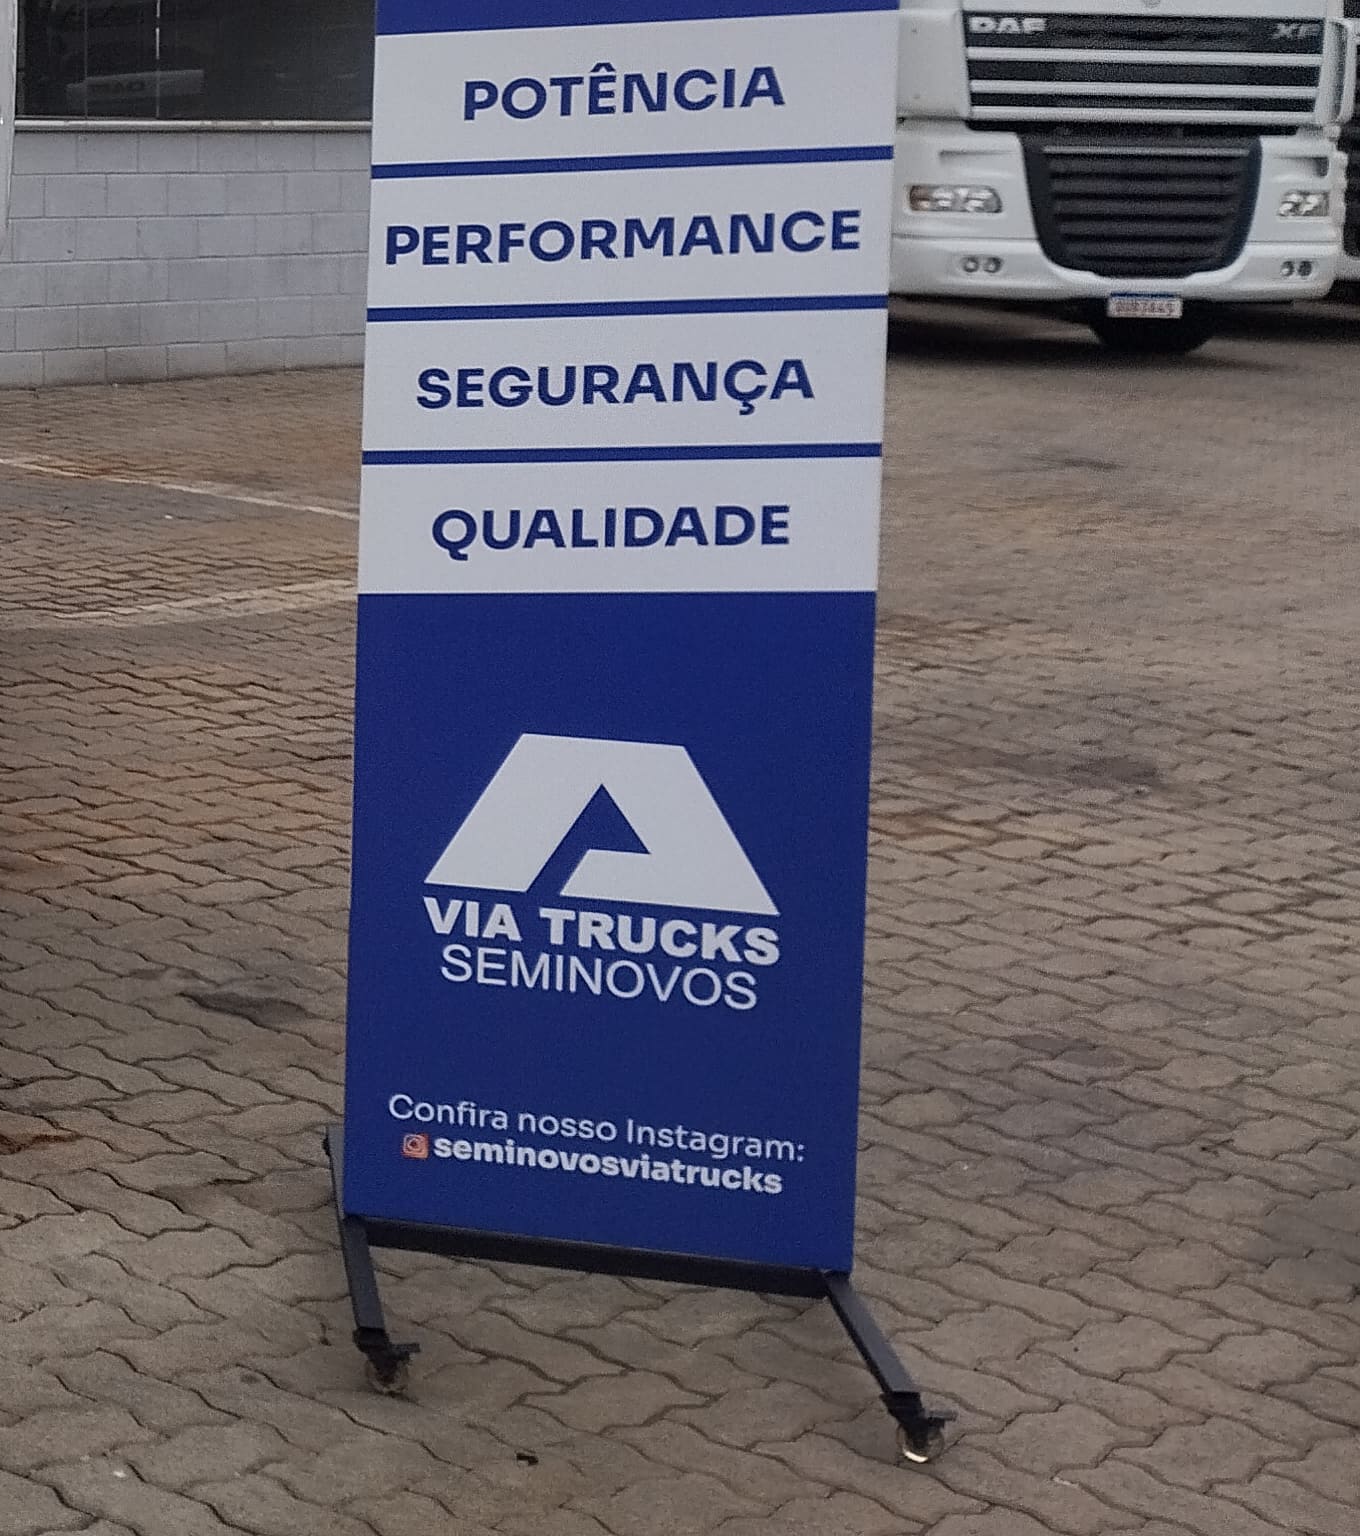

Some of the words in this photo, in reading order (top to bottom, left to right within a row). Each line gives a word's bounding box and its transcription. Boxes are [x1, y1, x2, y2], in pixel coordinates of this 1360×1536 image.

[969, 17, 1047, 35] DAF
[1272, 22, 1321, 40] XF
[463, 61, 785, 121] POTÊNCIA
[385, 209, 861, 266] PERFORMANCE
[416, 358, 815, 416] SEGURANÇA
[431, 504, 791, 562] QUALIDADE
[422, 895, 522, 942] VIA
[538, 906, 781, 966] TRUCKS
[440, 943, 759, 1011] SEMINOVOS
[388, 1093, 509, 1131] Confira
[518, 1110, 617, 1144] nosso
[626, 1118, 806, 1163] Instagram:
[433, 1135, 783, 1195] seminovosviatrucks
